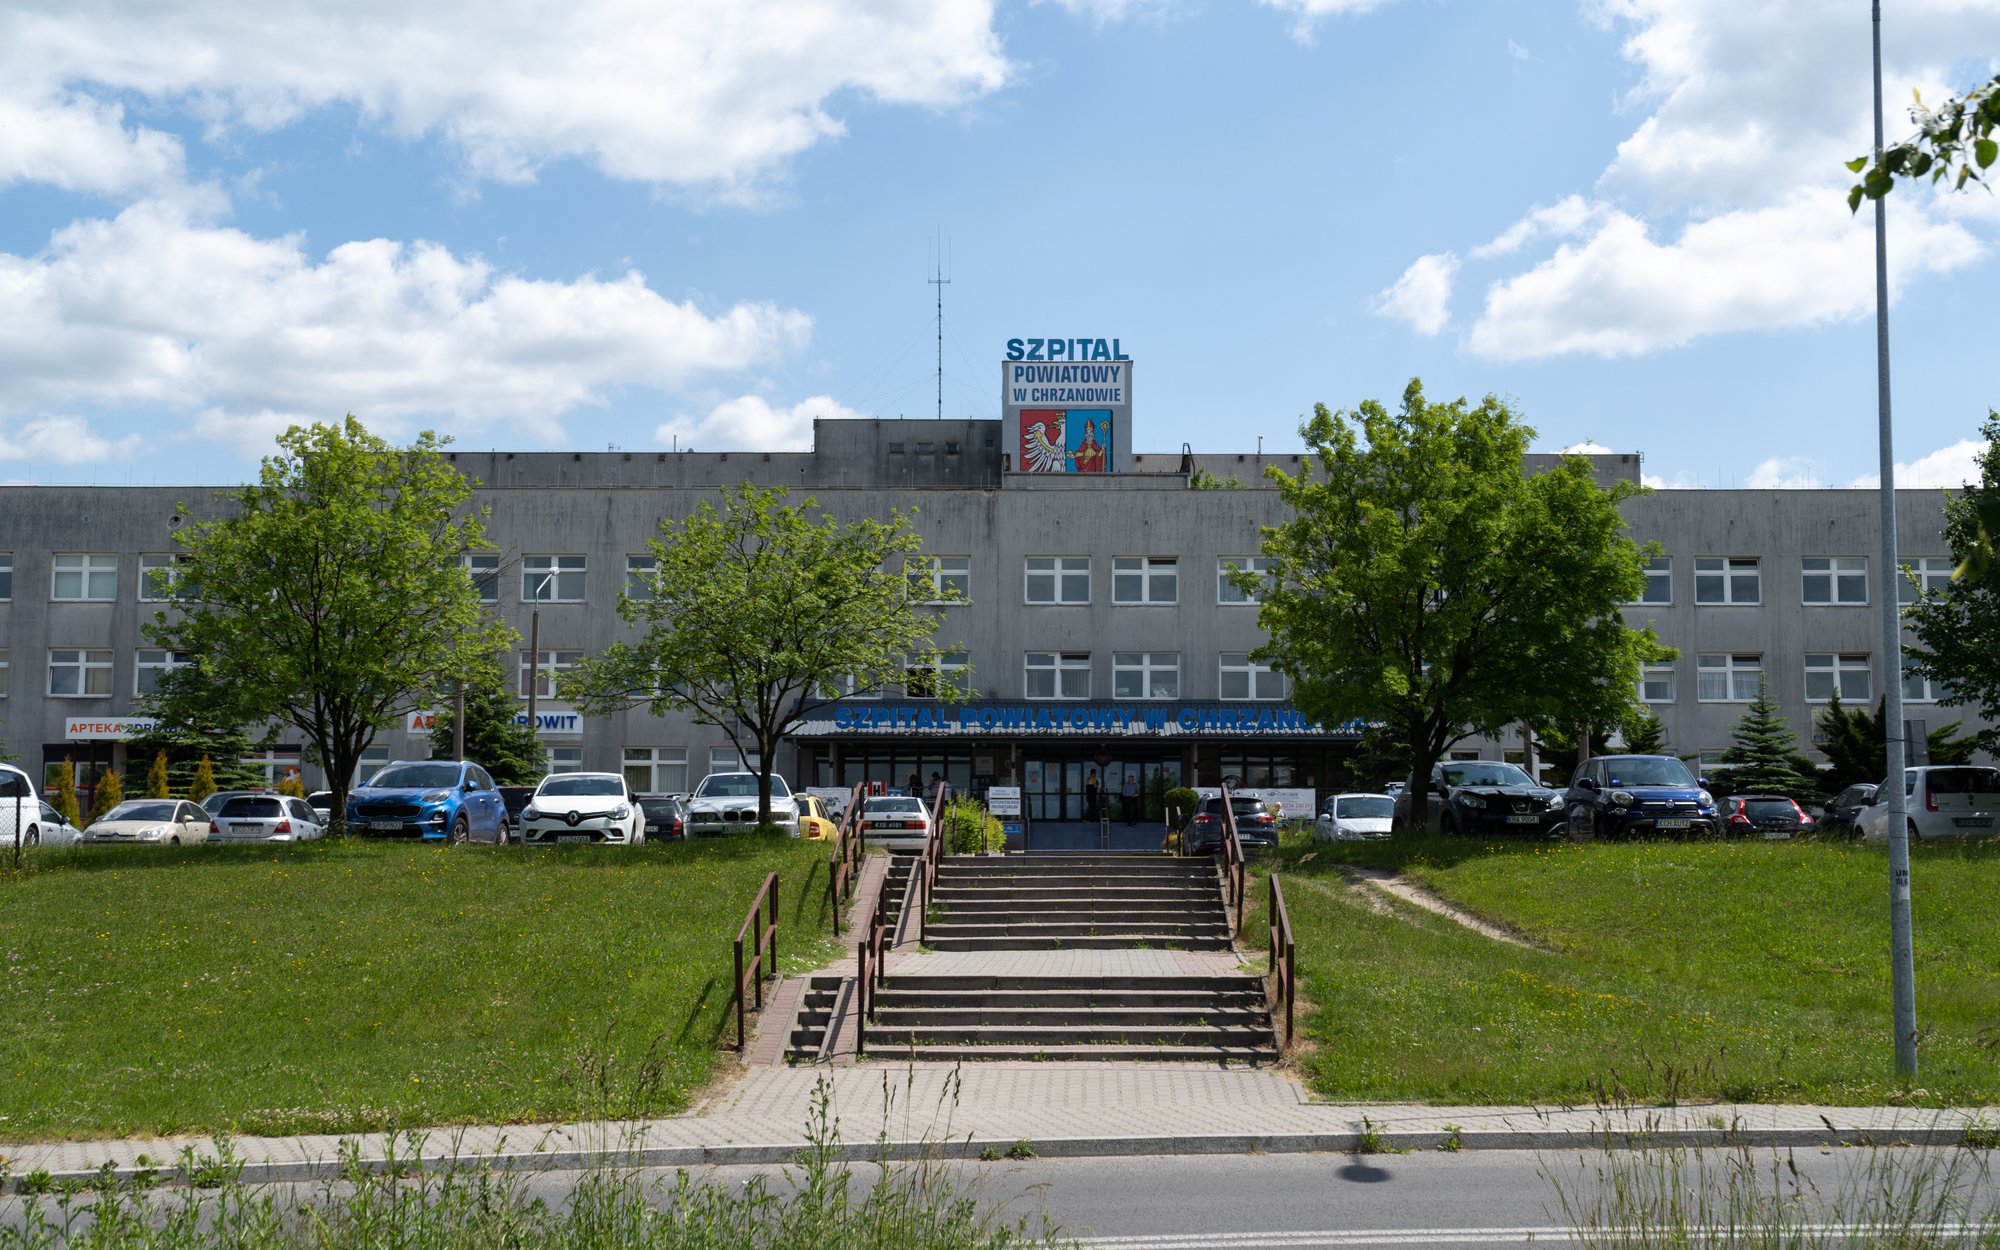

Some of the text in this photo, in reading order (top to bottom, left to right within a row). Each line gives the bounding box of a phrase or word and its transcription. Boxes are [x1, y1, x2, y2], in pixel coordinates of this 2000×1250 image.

[1006, 338, 1129, 361] SZPITAL
[1014, 365, 1121, 383] POWIATOWY
[1013, 388, 1121, 402] W CHRZANOWIE
[834, 707, 1367, 731] SZPITAL POWIATOWY W CHRZANO
[69, 723, 122, 733] APTEKA
[1659, 819, 1689, 827] KCH XU12
